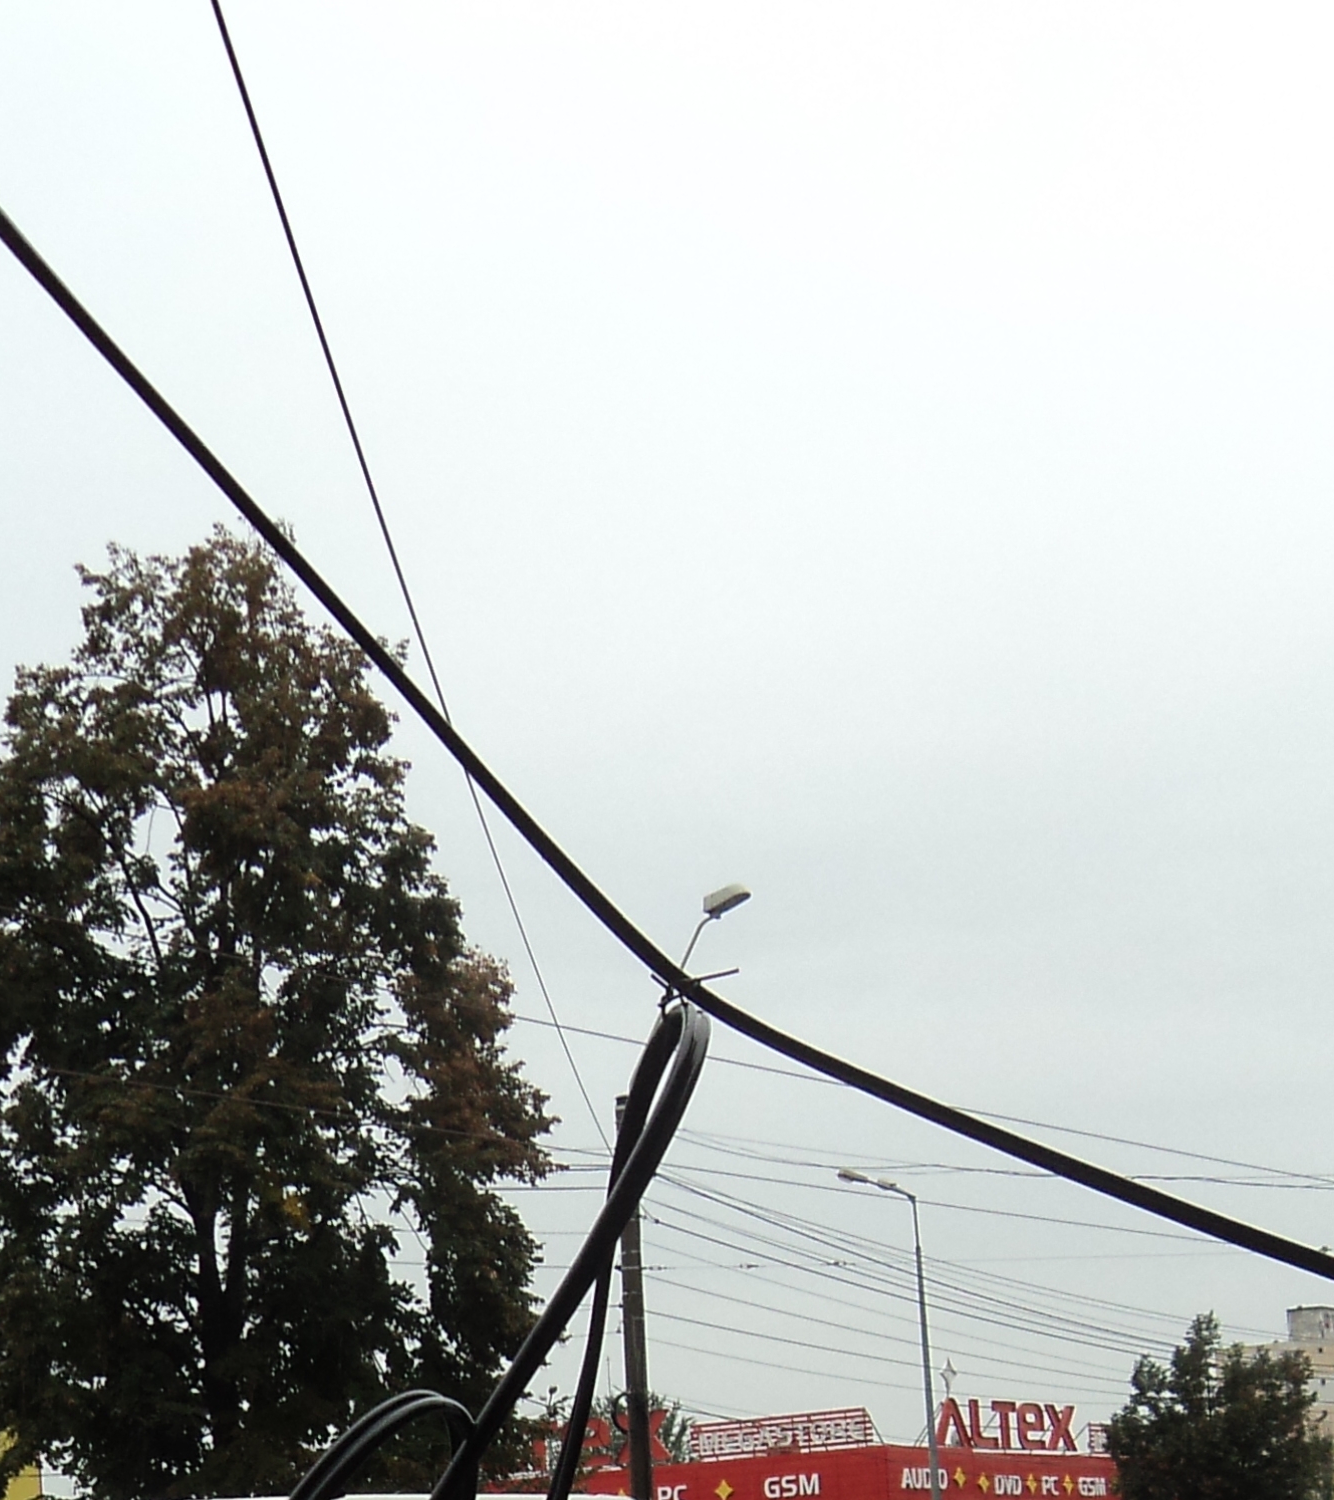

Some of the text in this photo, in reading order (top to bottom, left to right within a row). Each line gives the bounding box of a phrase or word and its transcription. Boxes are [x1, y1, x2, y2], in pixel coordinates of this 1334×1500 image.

[764, 1473, 820, 1499] GSM
[901, 1467, 1107, 1497] AUDO DVD PC GSM
